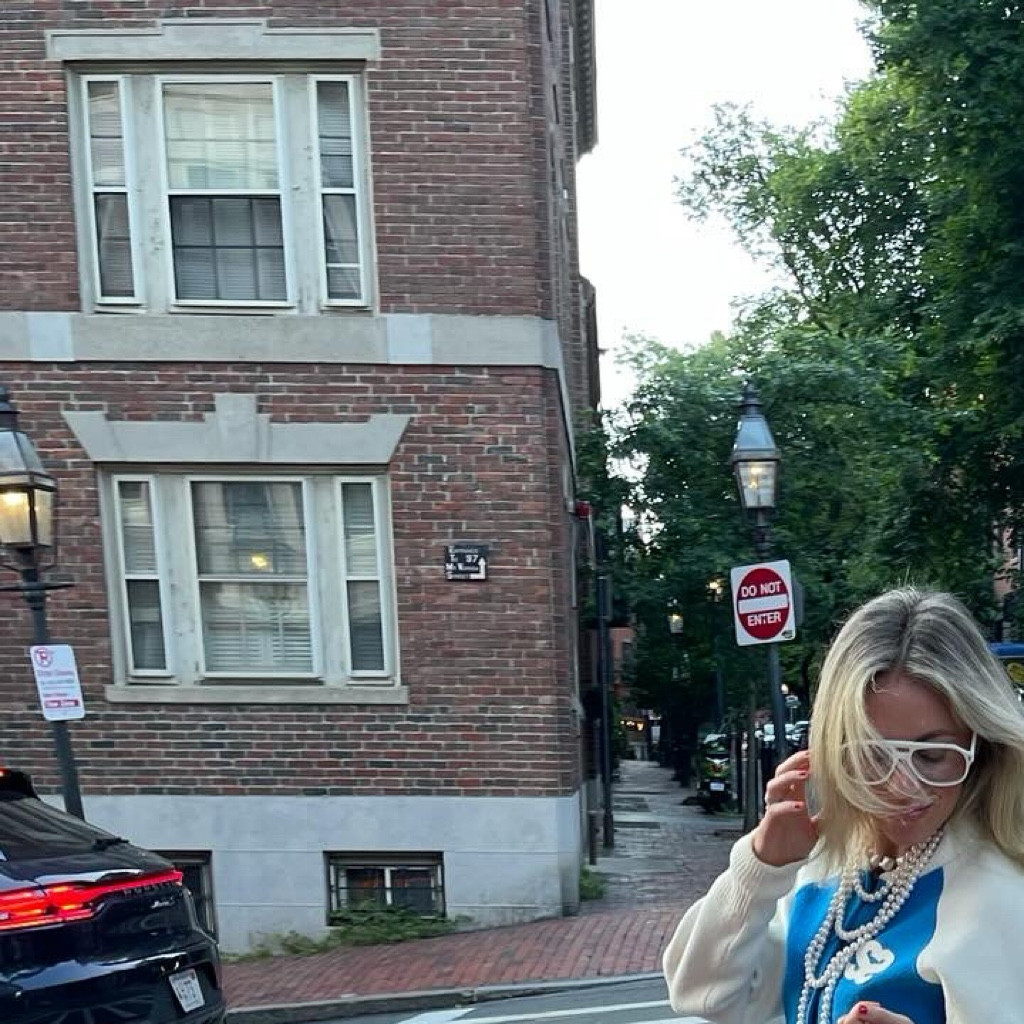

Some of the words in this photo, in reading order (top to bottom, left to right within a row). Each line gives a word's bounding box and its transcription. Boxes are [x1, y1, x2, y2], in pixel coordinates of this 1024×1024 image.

[741, 585, 757, 598] DO
[760, 581, 781, 594] NOT
[747, 611, 781, 626] ENTER
